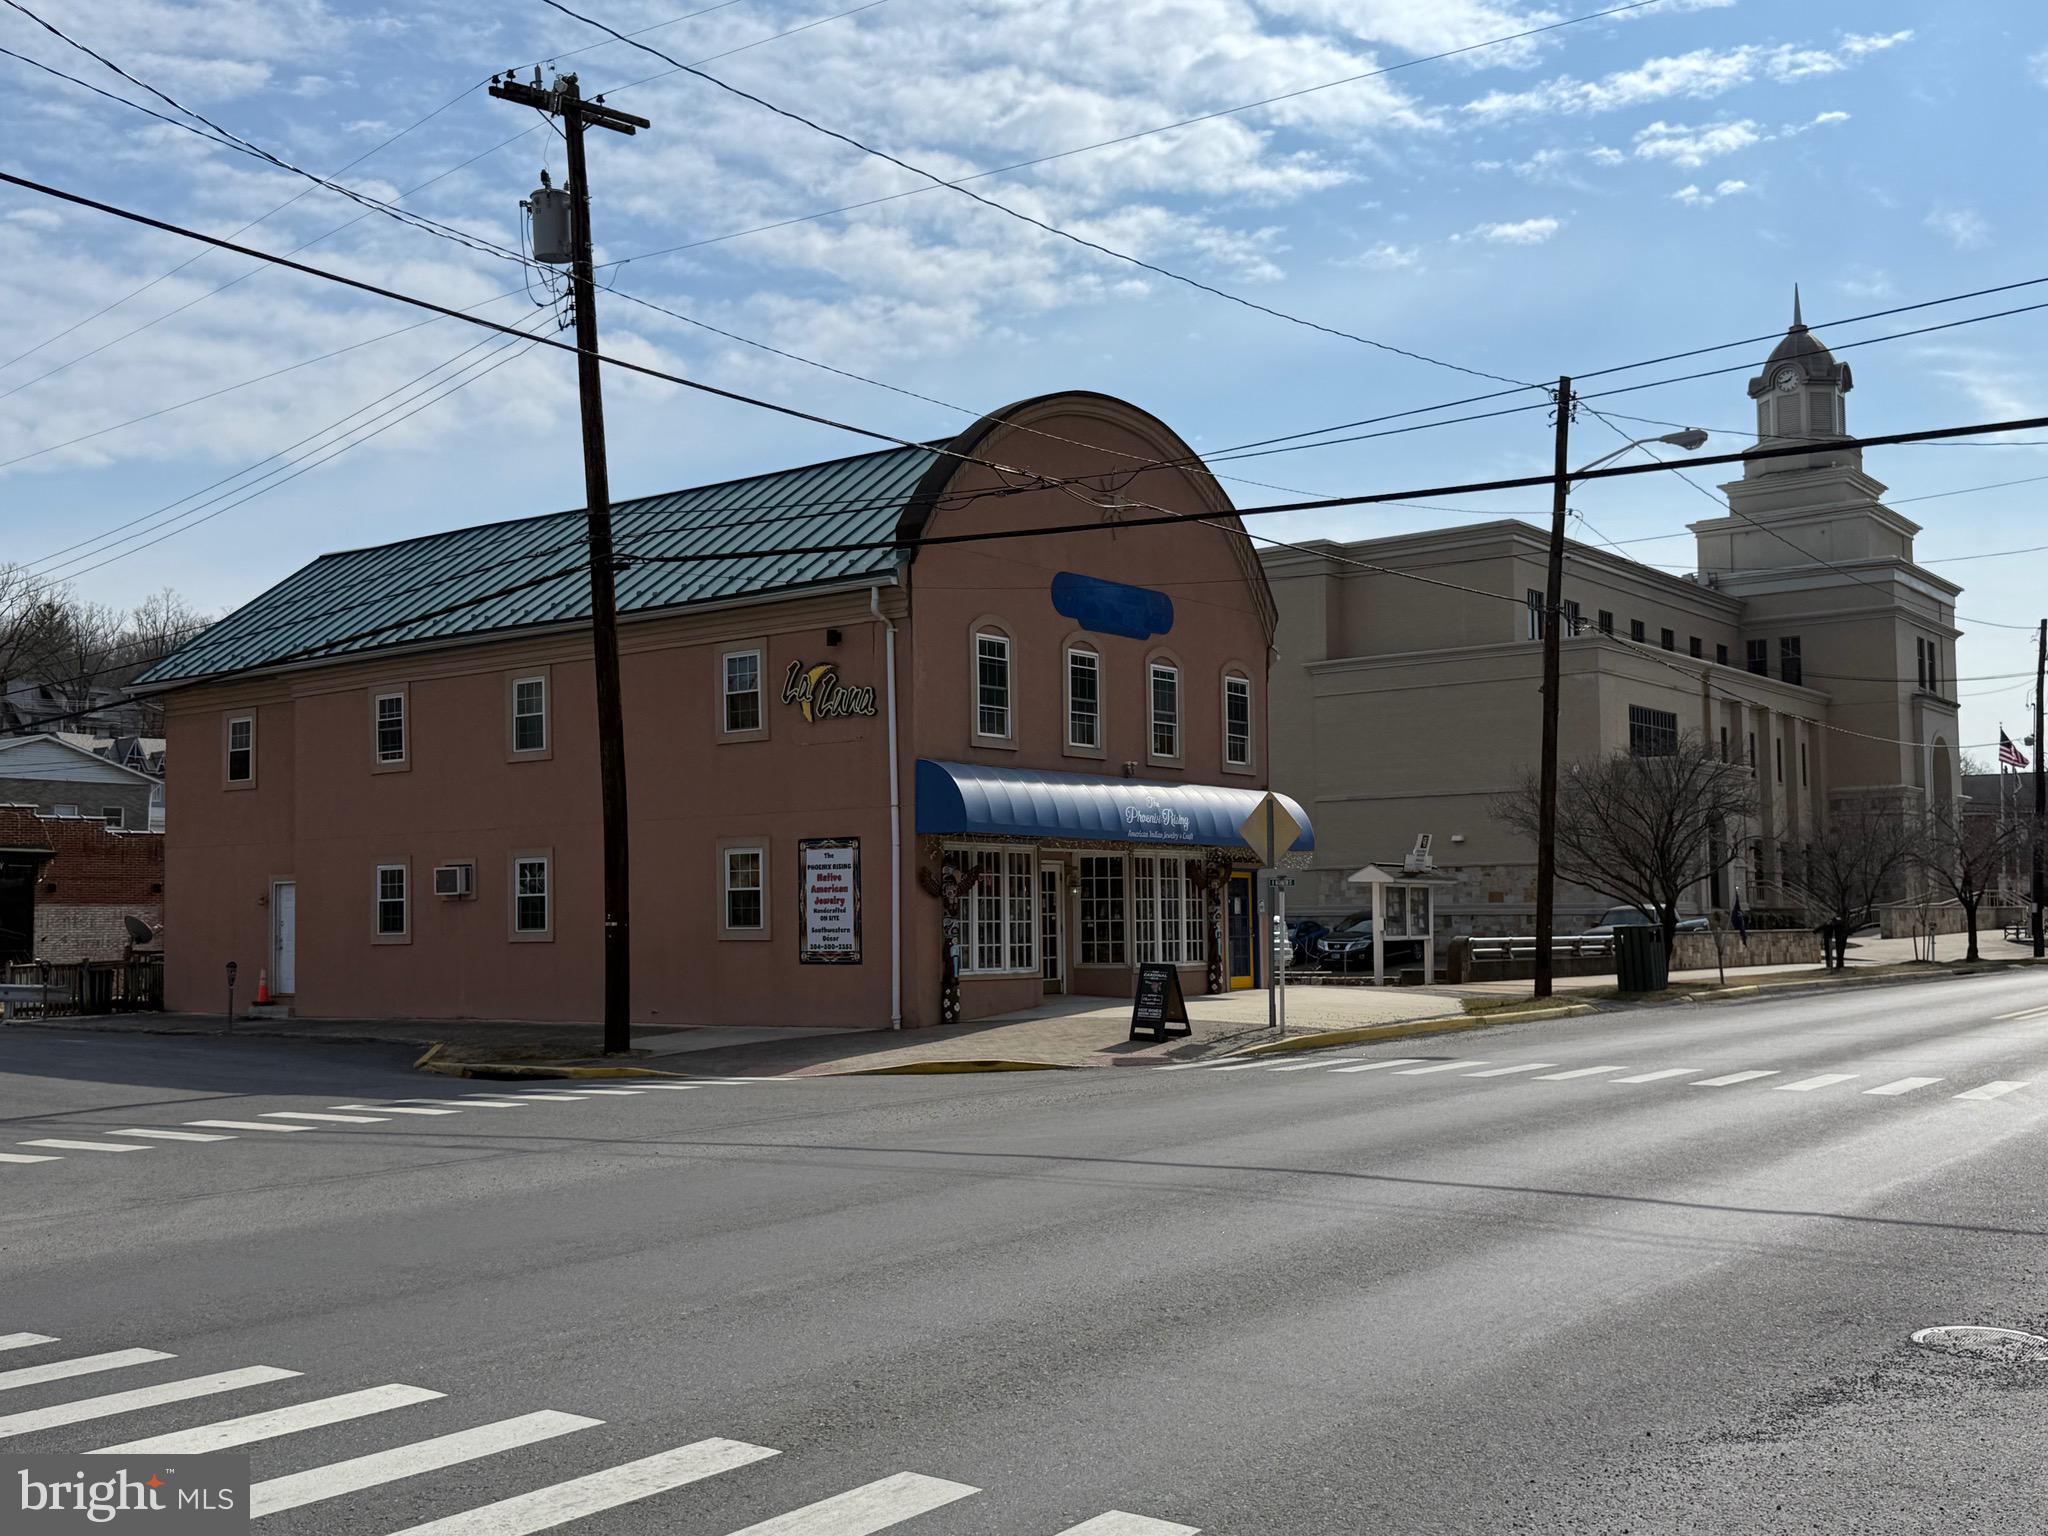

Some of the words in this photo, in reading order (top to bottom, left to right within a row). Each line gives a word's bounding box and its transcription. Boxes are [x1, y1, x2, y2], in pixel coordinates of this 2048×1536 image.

[782, 660, 813, 704] La
[816, 673, 875, 717] Luna
[1125, 806, 1161, 824] Phoenix
[1162, 808, 1190, 831] Rising
[817, 873, 842, 882] Native
[811, 884, 848, 893] American
[814, 896, 845, 907] Jewelry
